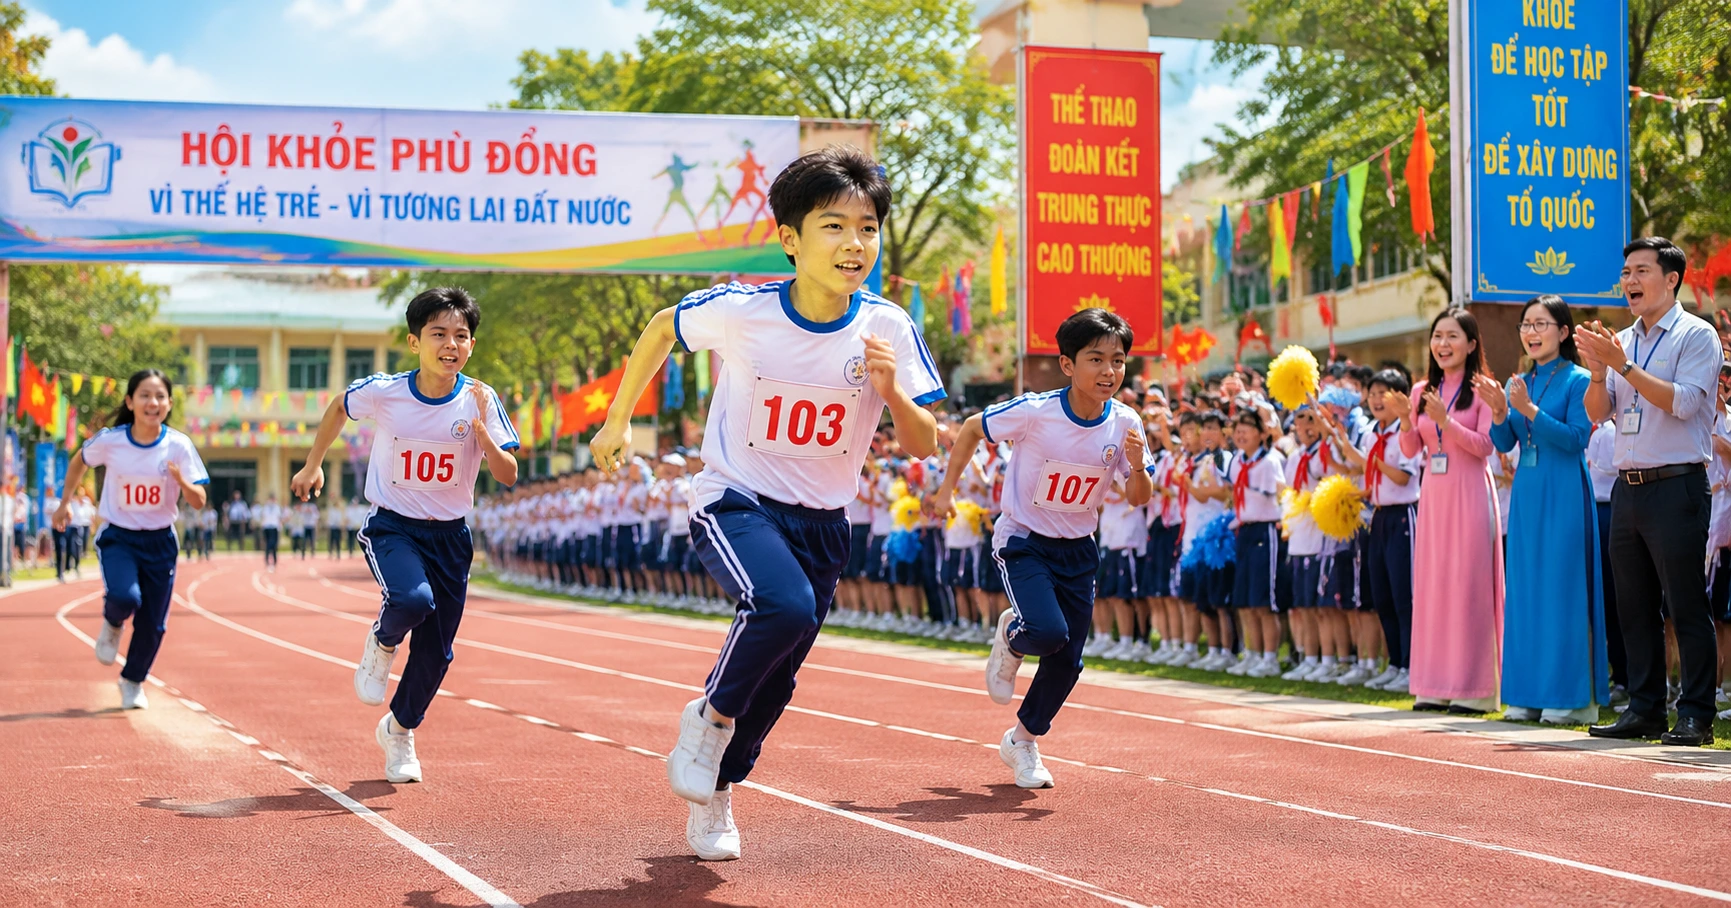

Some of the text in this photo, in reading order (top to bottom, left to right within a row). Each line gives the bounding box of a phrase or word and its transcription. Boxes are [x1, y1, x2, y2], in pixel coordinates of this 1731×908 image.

[1490, 32, 1608, 87] ĐỂ HỌC TẬP
[1049, 83, 1137, 128] THỂ THAO
[1531, 86, 1569, 128] TỐT
[182, 121, 597, 177] HỘI KHỎE PHÙ ĐỔNG
[1048, 136, 1140, 178] ĐOÀN KẾT
[1483, 131, 1618, 186] ĐỂ XÂY DỰNG
[149, 182, 172, 214] VÌ
[181, 180, 229, 216] THẾ
[236, 185, 267, 223] HỆ
[347, 187, 371, 219] VÌ
[379, 191, 461, 222] TƯƠNG
[469, 196, 505, 223] LAI
[513, 189, 560, 224] ĐẤT
[567, 194, 631, 226] NƯỚC
[1036, 191, 1152, 234] TRUNG THỰC
[1507, 184, 1595, 232] TỔ QUỐC
[1036, 241, 1152, 283] CAO THƯỢNG
[763, 394, 847, 448] 103
[400, 450, 455, 483] 105
[1045, 471, 1101, 506] 107
[123, 483, 162, 506] 108
